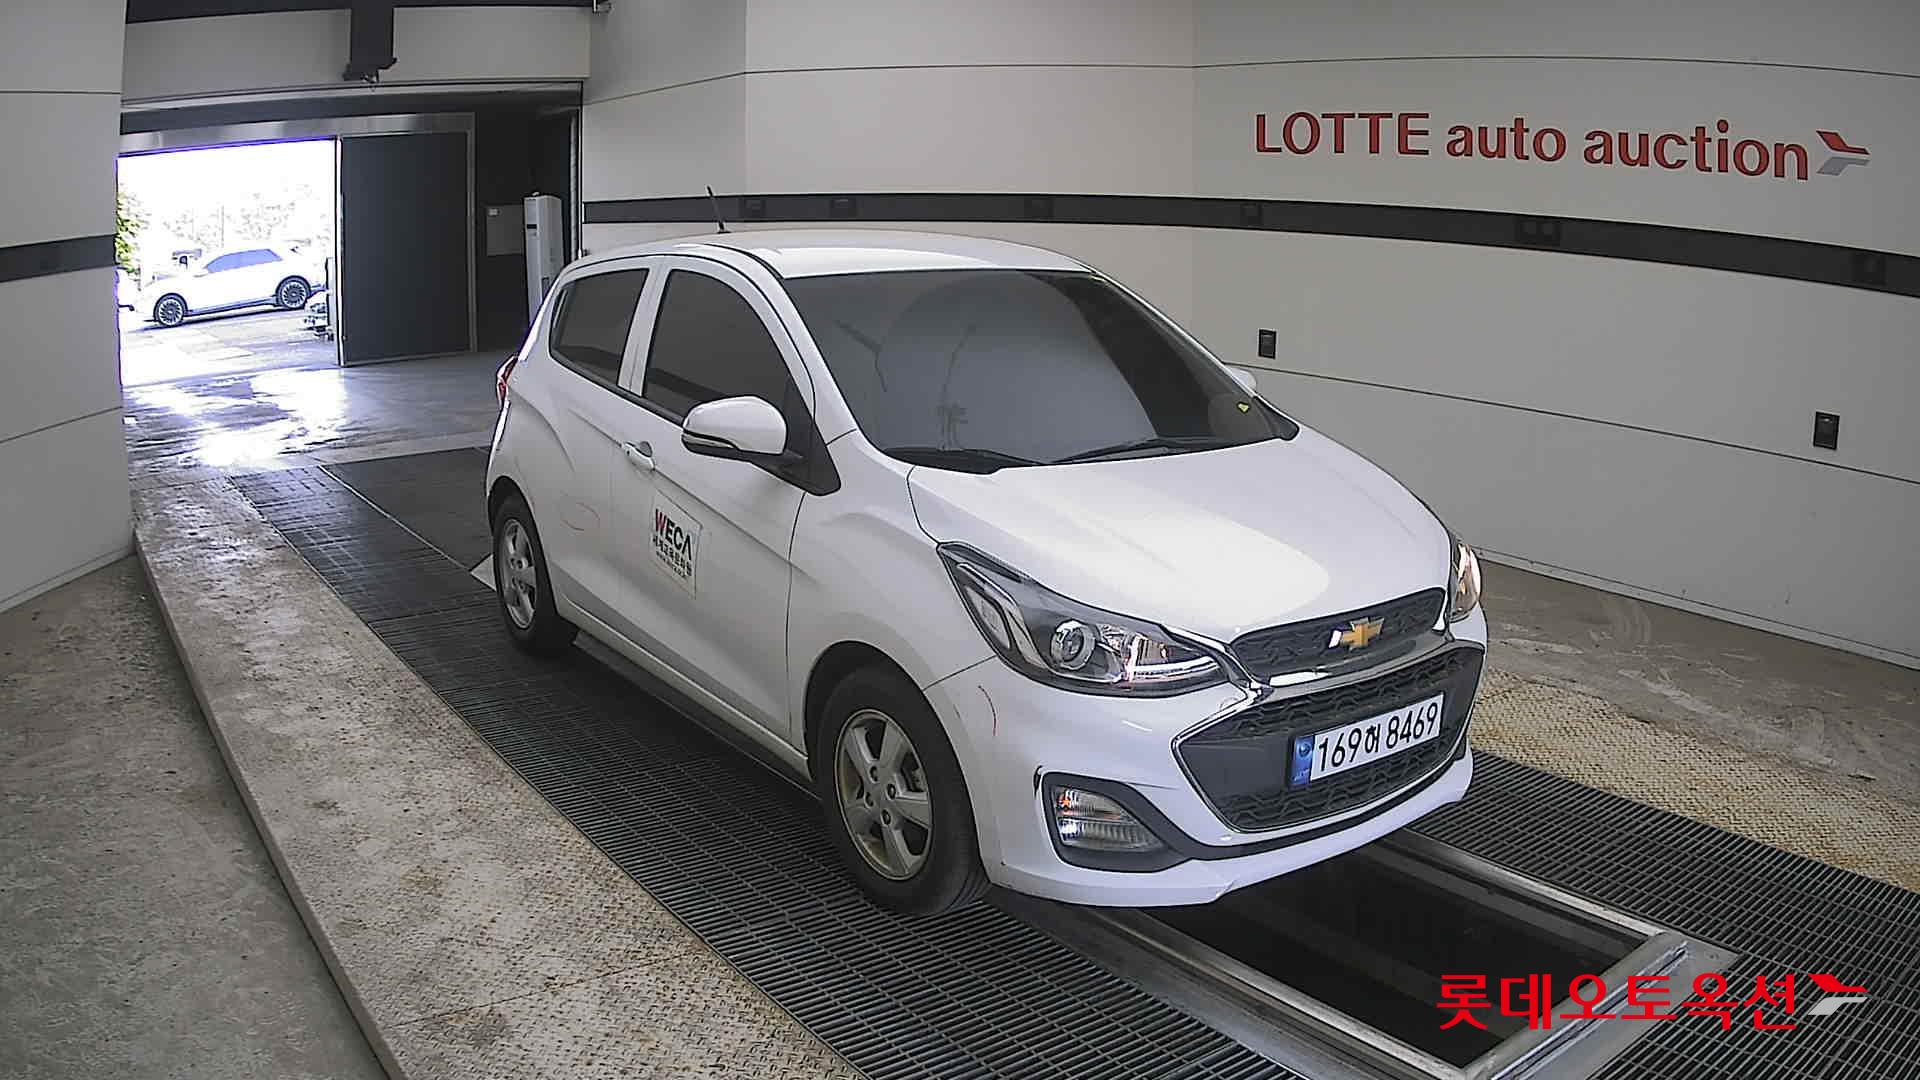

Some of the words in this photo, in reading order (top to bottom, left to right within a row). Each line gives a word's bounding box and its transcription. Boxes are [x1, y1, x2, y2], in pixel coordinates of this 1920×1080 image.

[1256, 111, 1429, 155] LOTTE
[1446, 117, 1567, 161] auto
[1583, 119, 1808, 180] auction
[1318, 723, 1381, 772] 169허
[1386, 702, 1438, 750] 8469
